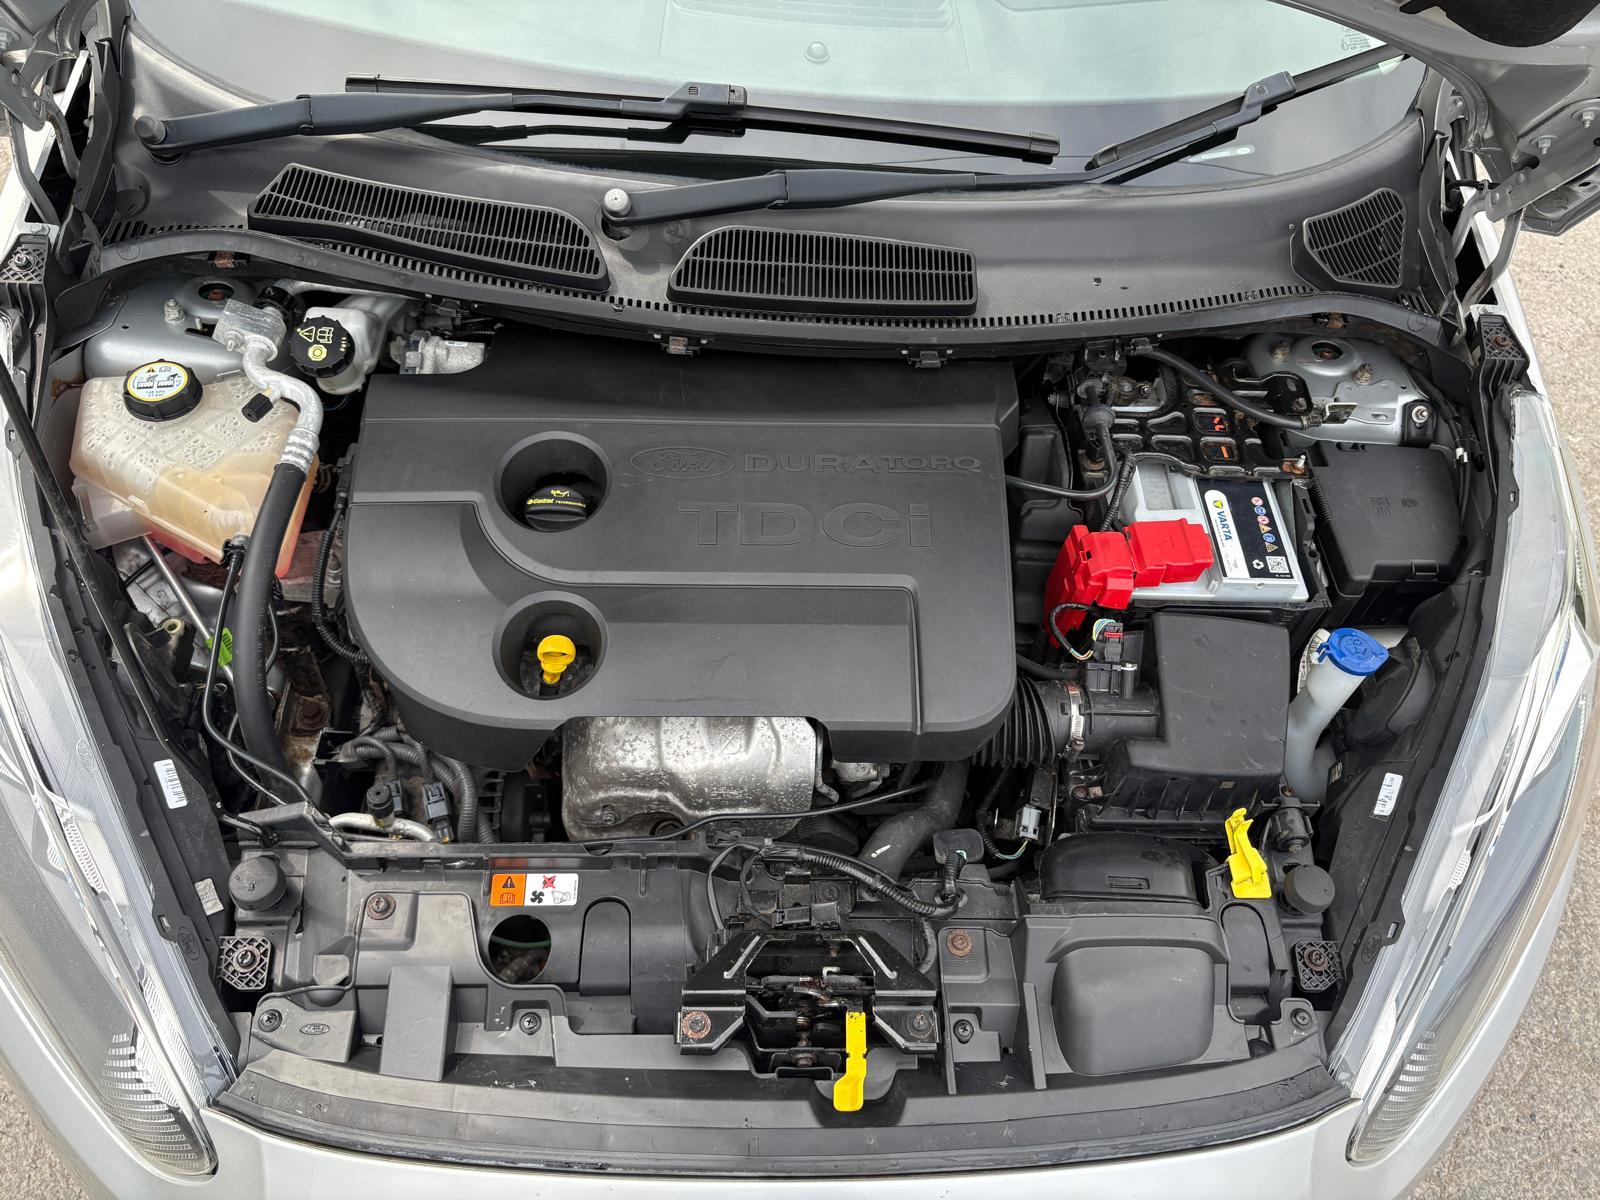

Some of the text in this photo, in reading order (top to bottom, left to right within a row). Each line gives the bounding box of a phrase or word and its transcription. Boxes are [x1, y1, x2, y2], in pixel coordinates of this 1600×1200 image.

[744, 453, 982, 474] DURATORQ
[678, 501, 933, 548] TDCi
[1216, 510, 1233, 541] VARTA
